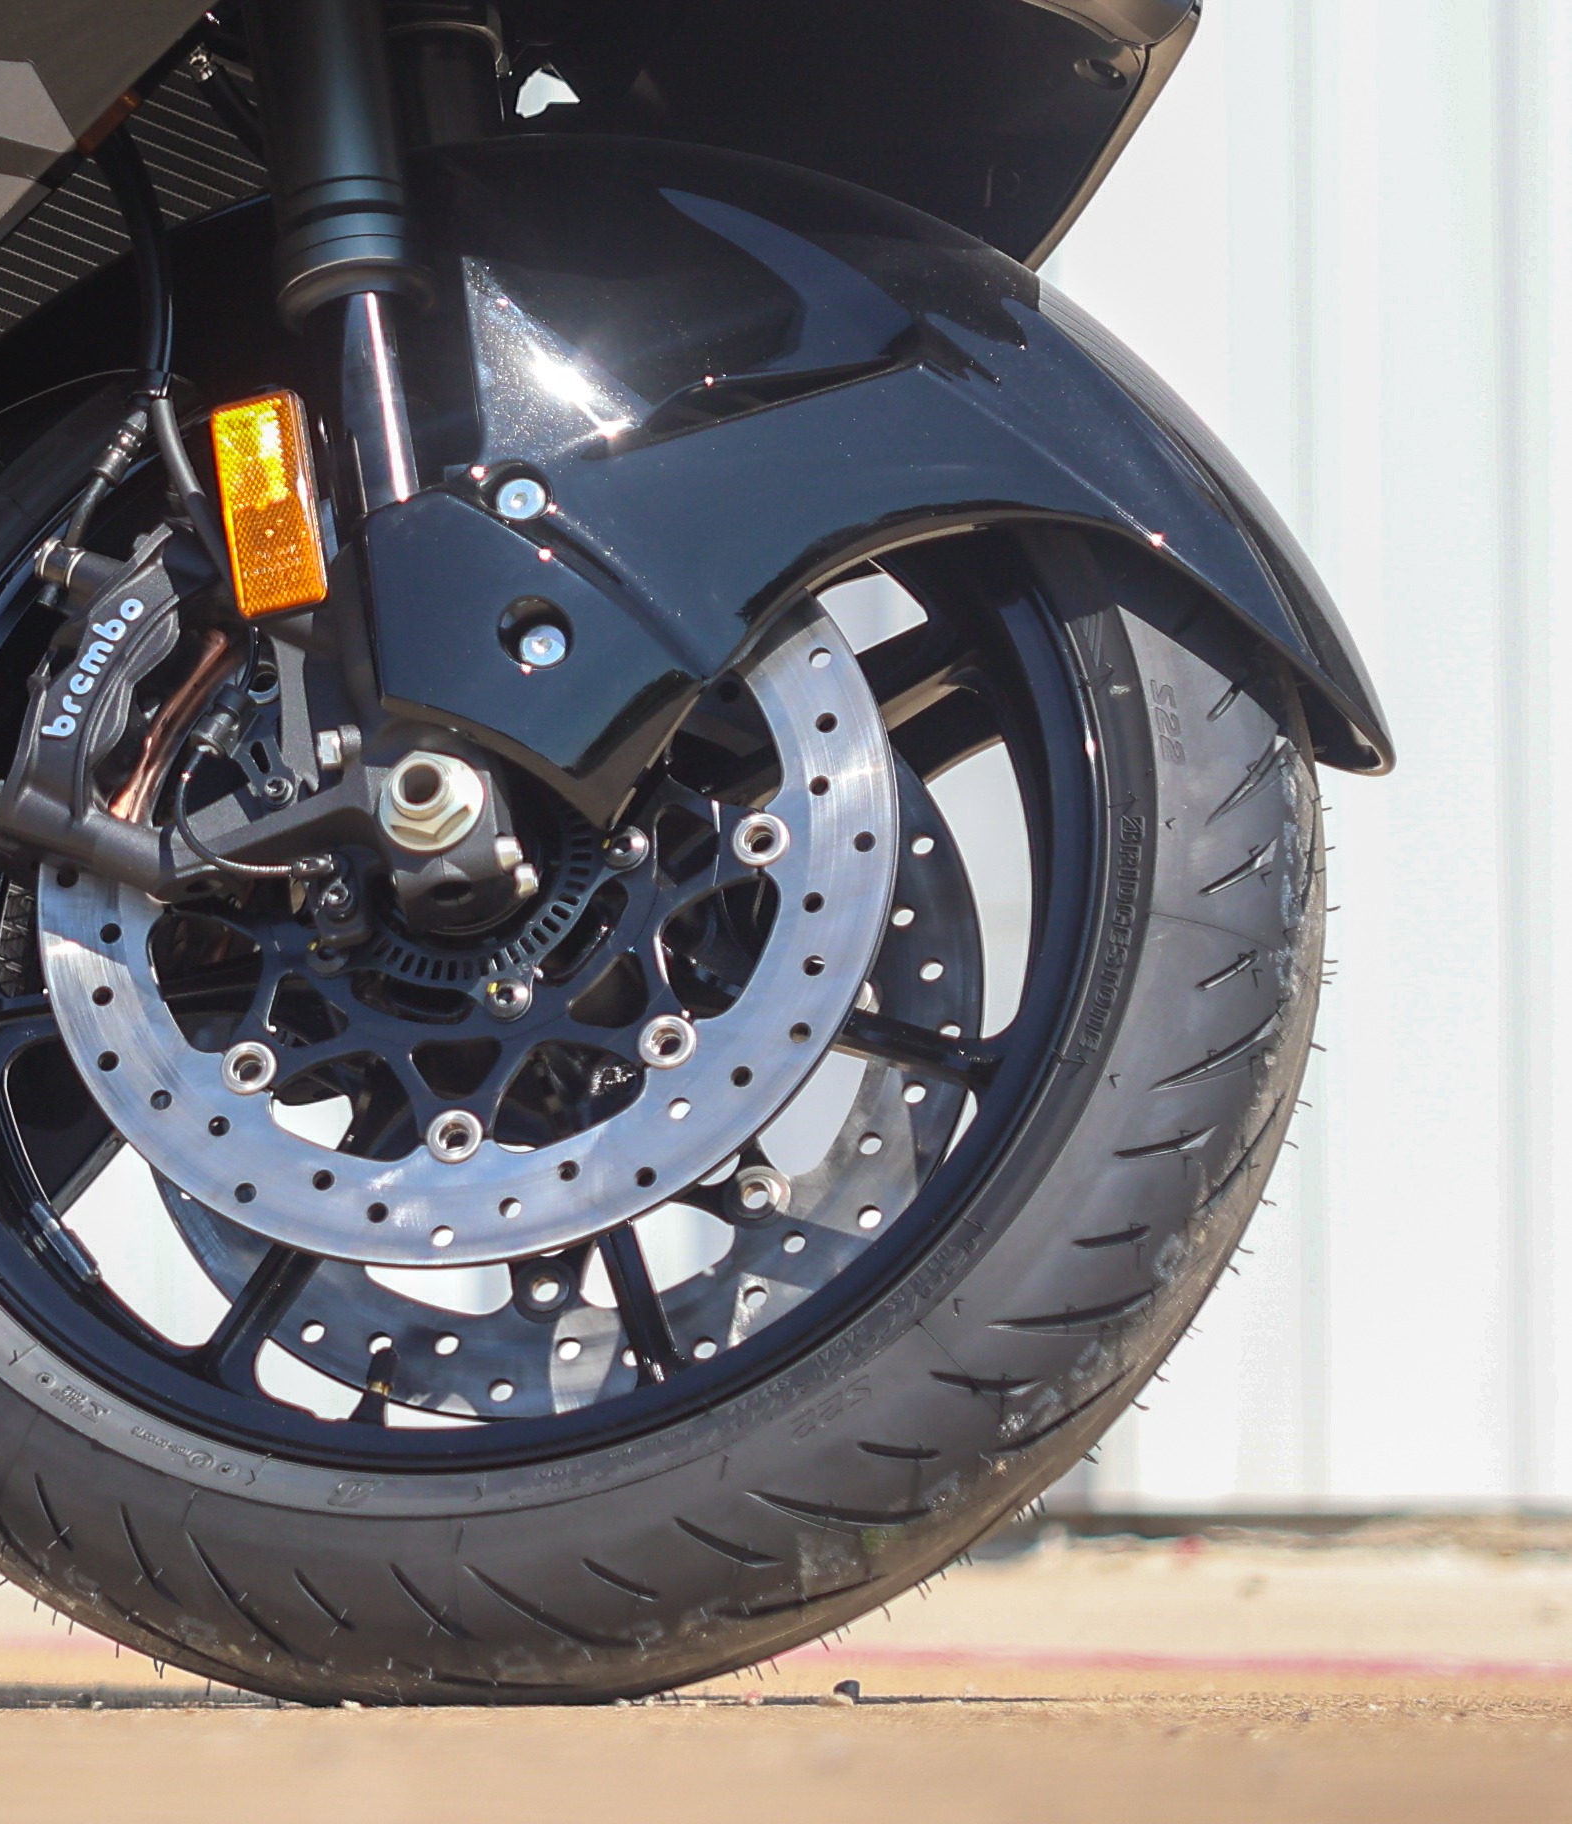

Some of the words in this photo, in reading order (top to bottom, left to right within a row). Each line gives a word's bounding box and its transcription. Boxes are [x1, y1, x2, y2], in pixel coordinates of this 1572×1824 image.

[41, 598, 144, 738] brembo
[1149, 678, 1187, 766] S22
[1075, 814, 1146, 1053] BRIDGESTONE
